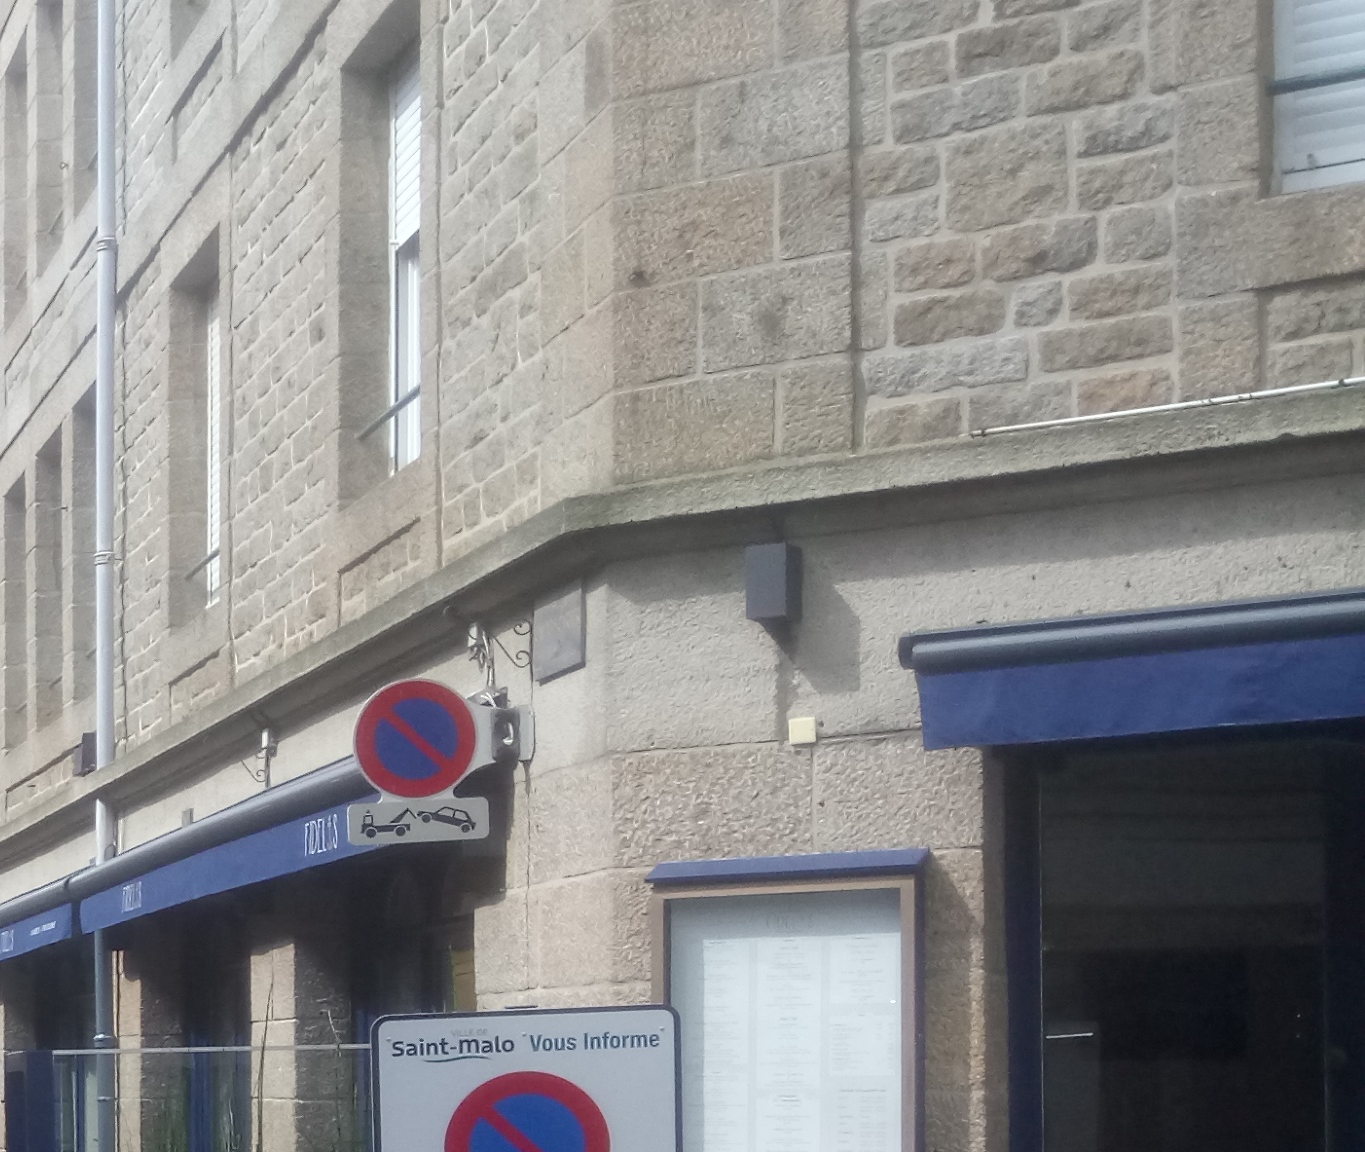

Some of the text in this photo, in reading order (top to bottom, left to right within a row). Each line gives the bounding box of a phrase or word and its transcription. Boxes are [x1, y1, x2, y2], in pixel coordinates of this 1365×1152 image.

[391, 1032, 660, 1057] Saint-malo Vous Informe
